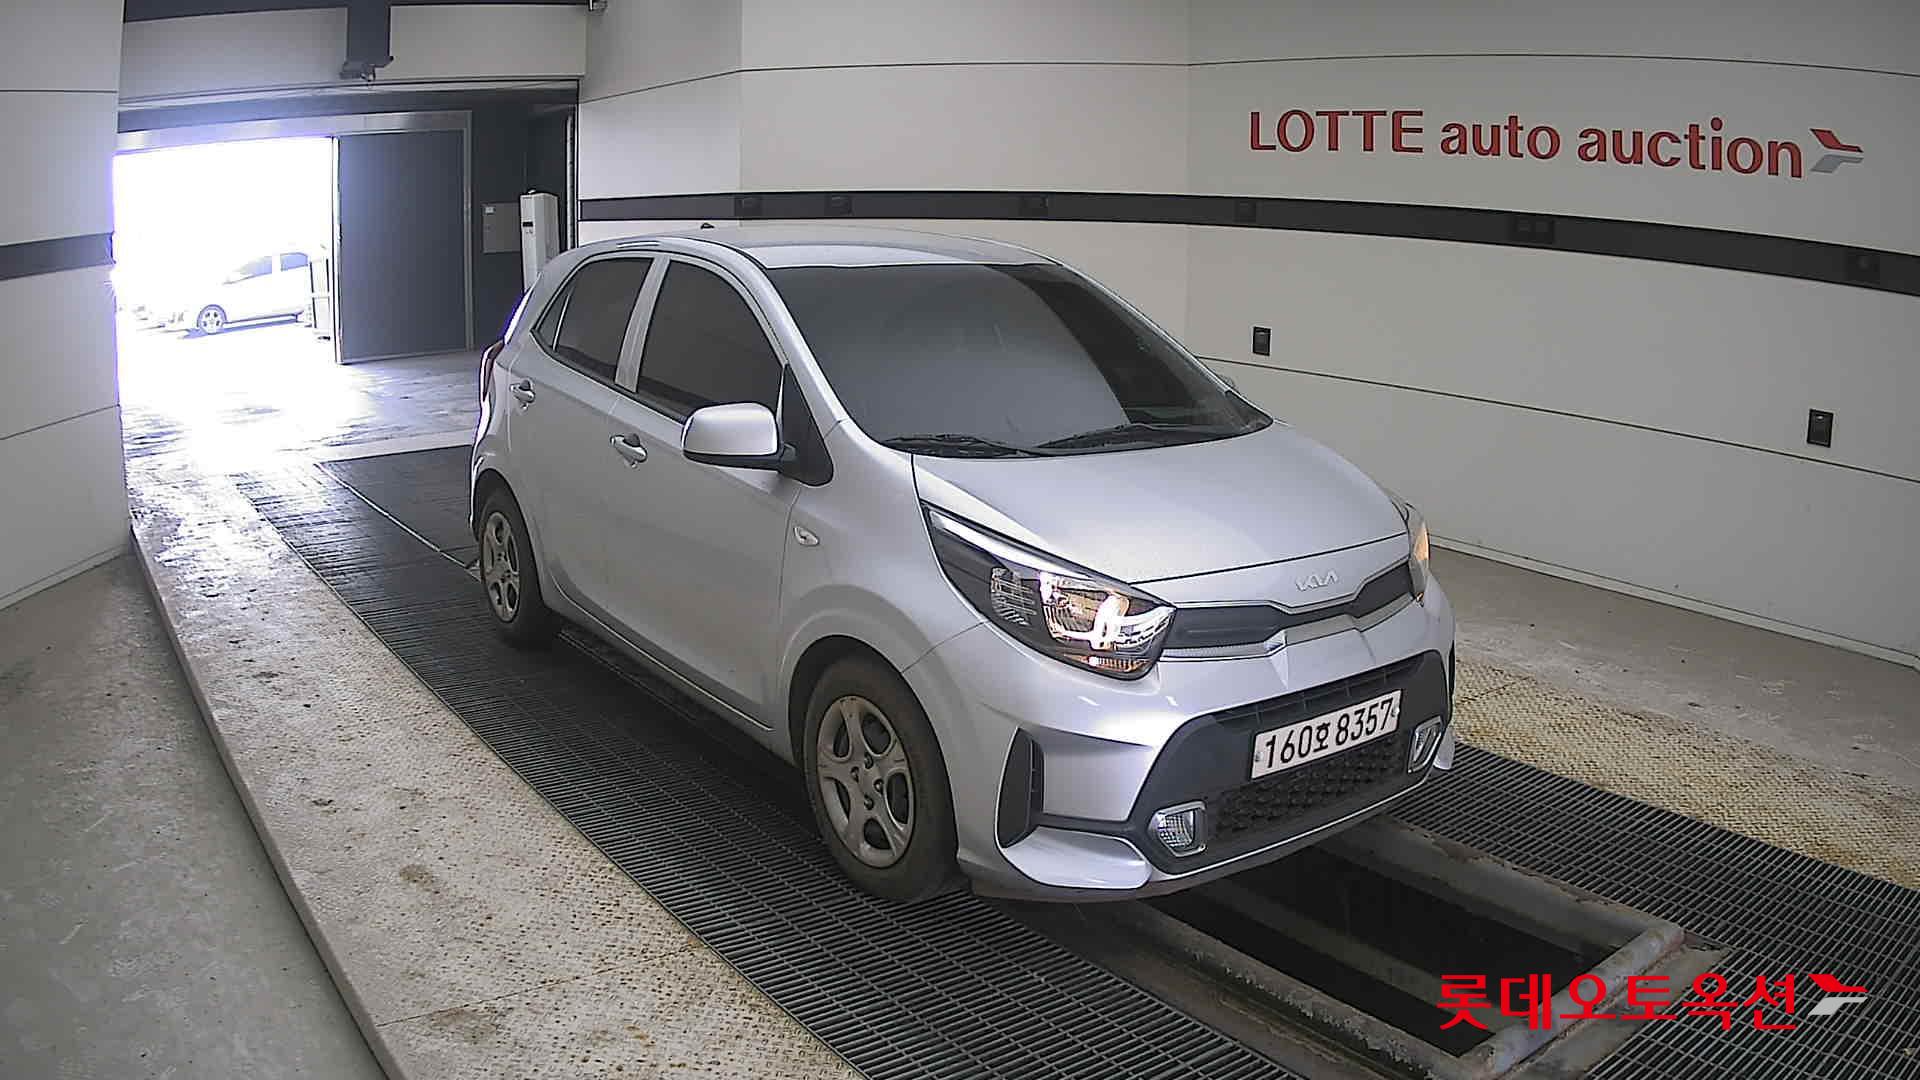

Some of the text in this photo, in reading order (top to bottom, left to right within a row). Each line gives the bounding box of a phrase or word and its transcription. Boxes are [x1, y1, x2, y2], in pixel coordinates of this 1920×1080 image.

[1250, 110, 1803, 179] LOTTE auto auction
[1335, 697, 1394, 746] 8357
